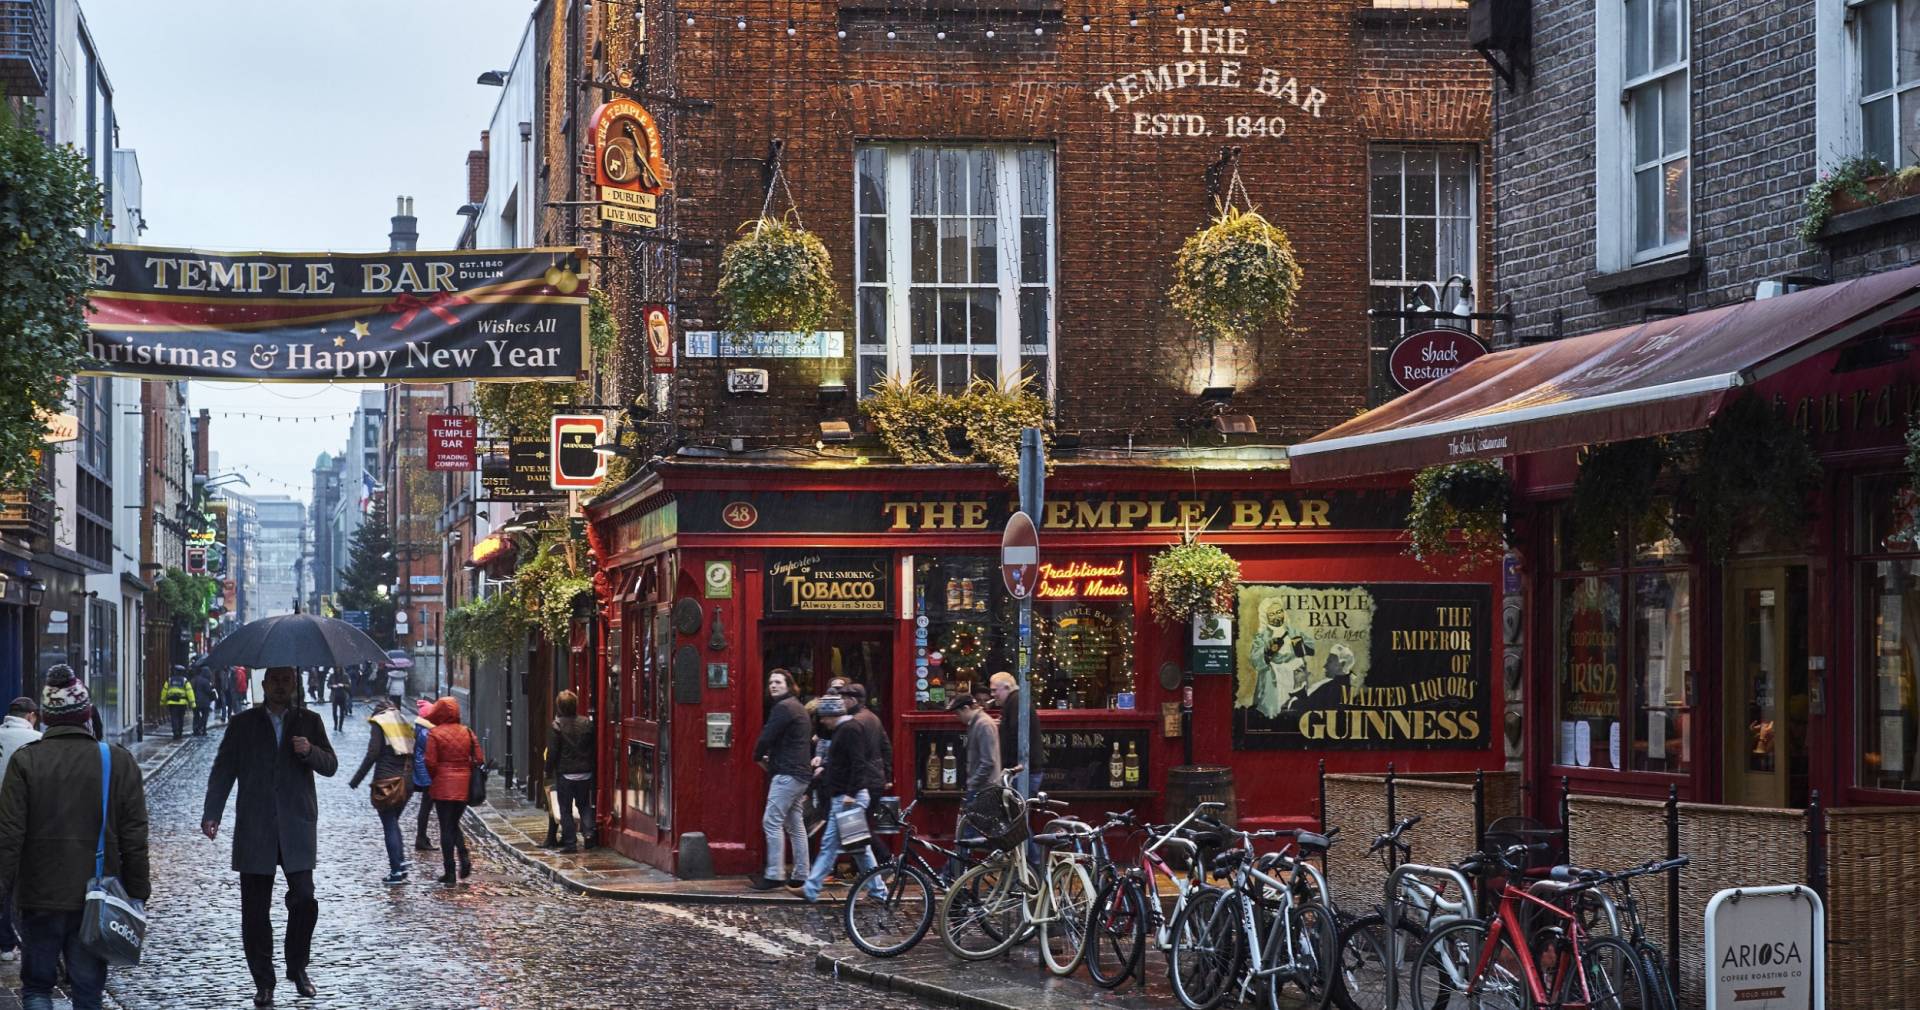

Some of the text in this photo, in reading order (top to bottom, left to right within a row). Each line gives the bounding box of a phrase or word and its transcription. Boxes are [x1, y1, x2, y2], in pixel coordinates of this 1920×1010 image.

[1177, 27, 1249, 54] THE
[1095, 60, 1327, 117] TEMPLE BAR
[598, 103, 658, 158] THE TEMPLE BAR
[1133, 112, 1286, 137] ESTD. 1840
[612, 190, 646, 204] DUBLIN
[606, 208, 652, 224] LIVE MUSIC
[459, 260, 503, 268] EST.1840
[145, 256, 335, 294] TEMPLE
[361, 261, 459, 294] BAR
[459, 270, 504, 279] DUBLIN
[477, 318, 557, 334] Wishes All
[86, 333, 561, 377] hristmas & Happy New Year
[757, 346, 784, 354] LANE
[787, 346, 820, 355] SOUTH
[1421, 341, 1459, 362] Shack
[442, 419, 462, 428] THE
[432, 429, 473, 438] TEMPLE
[440, 439, 463, 448] BAR
[434, 460, 470, 468] COMPANY
[437, 453, 468, 461] TRADING
[515, 465, 535, 473] LIVE
[729, 505, 751, 523] 48
[884, 500, 1331, 529] THE EMPLE BAR
[770, 553, 821, 576] Importers
[1039, 560, 1125, 580] Traditional
[814, 571, 875, 579] FINE SMOKING
[783, 576, 876, 608] TOBACCO
[1036, 580, 1129, 597] Irish Music
[802, 601, 883, 609] Always in Stock
[1281, 594, 1371, 611] TEMPLE
[1308, 612, 1351, 629] BAR
[1437, 607, 1472, 628] THE
[1391, 630, 1471, 651] EMPEROR
[1452, 655, 1471, 674] OF
[1339, 676, 1478, 708] MALTED LIQUORS
[1298, 710, 1481, 740] GUINNESS
[1071, 733, 1106, 749] BAR
[109, 920, 140, 948] adidas
[1721, 941, 1802, 969] ARIOSA
[1720, 973, 1749, 983] COFFEE
[1751, 971, 1789, 980] ROASTING
